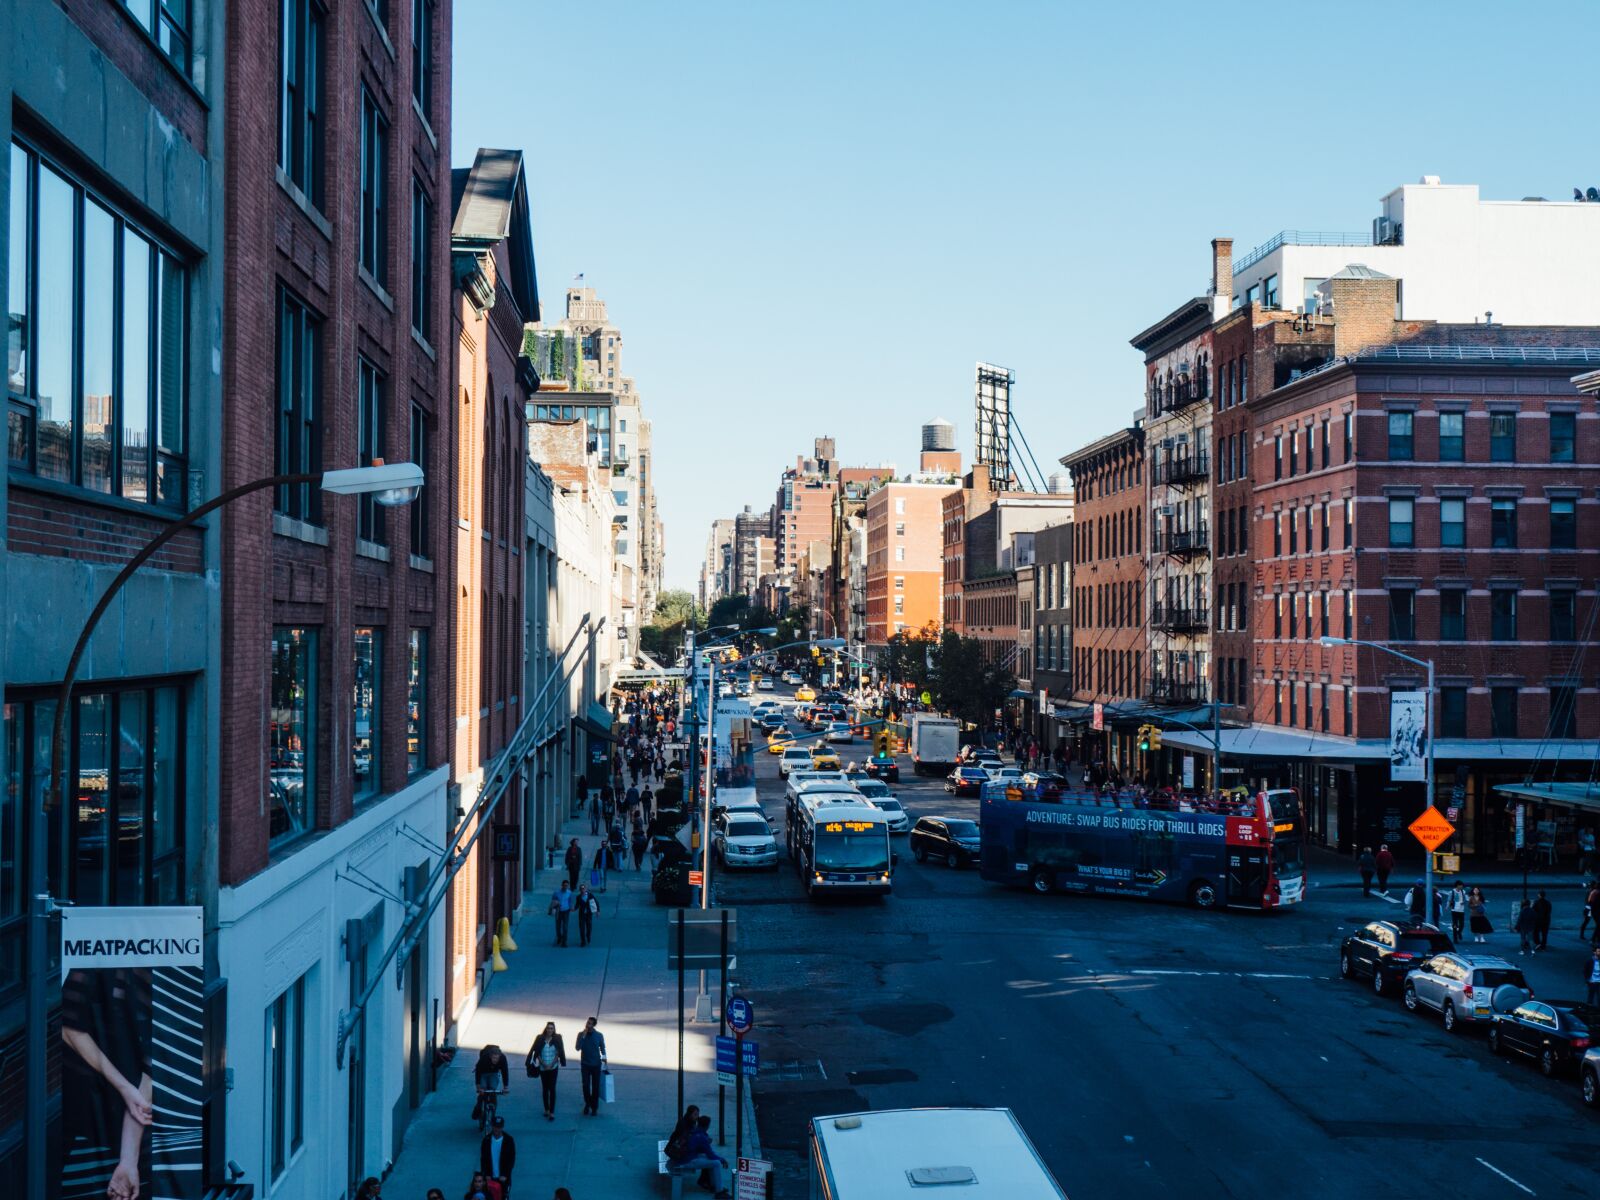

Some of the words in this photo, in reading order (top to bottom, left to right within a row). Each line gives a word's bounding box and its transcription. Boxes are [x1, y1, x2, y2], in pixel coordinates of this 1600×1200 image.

[1025, 810, 1075, 825] ADVENTURE:
[1077, 814, 1101, 827] SWAP
[1103, 816, 1119, 829] BUS
[1121, 817, 1146, 831] RIDES
[1148, 818, 1164, 832] FOR
[1167, 820, 1196, 835] THRILL
[1198, 822, 1224, 836] RIDES
[64, 938, 200, 956] MEATPACKING
[743, 1054, 756, 1064] M12
[740, 1160, 747, 1171] 3
